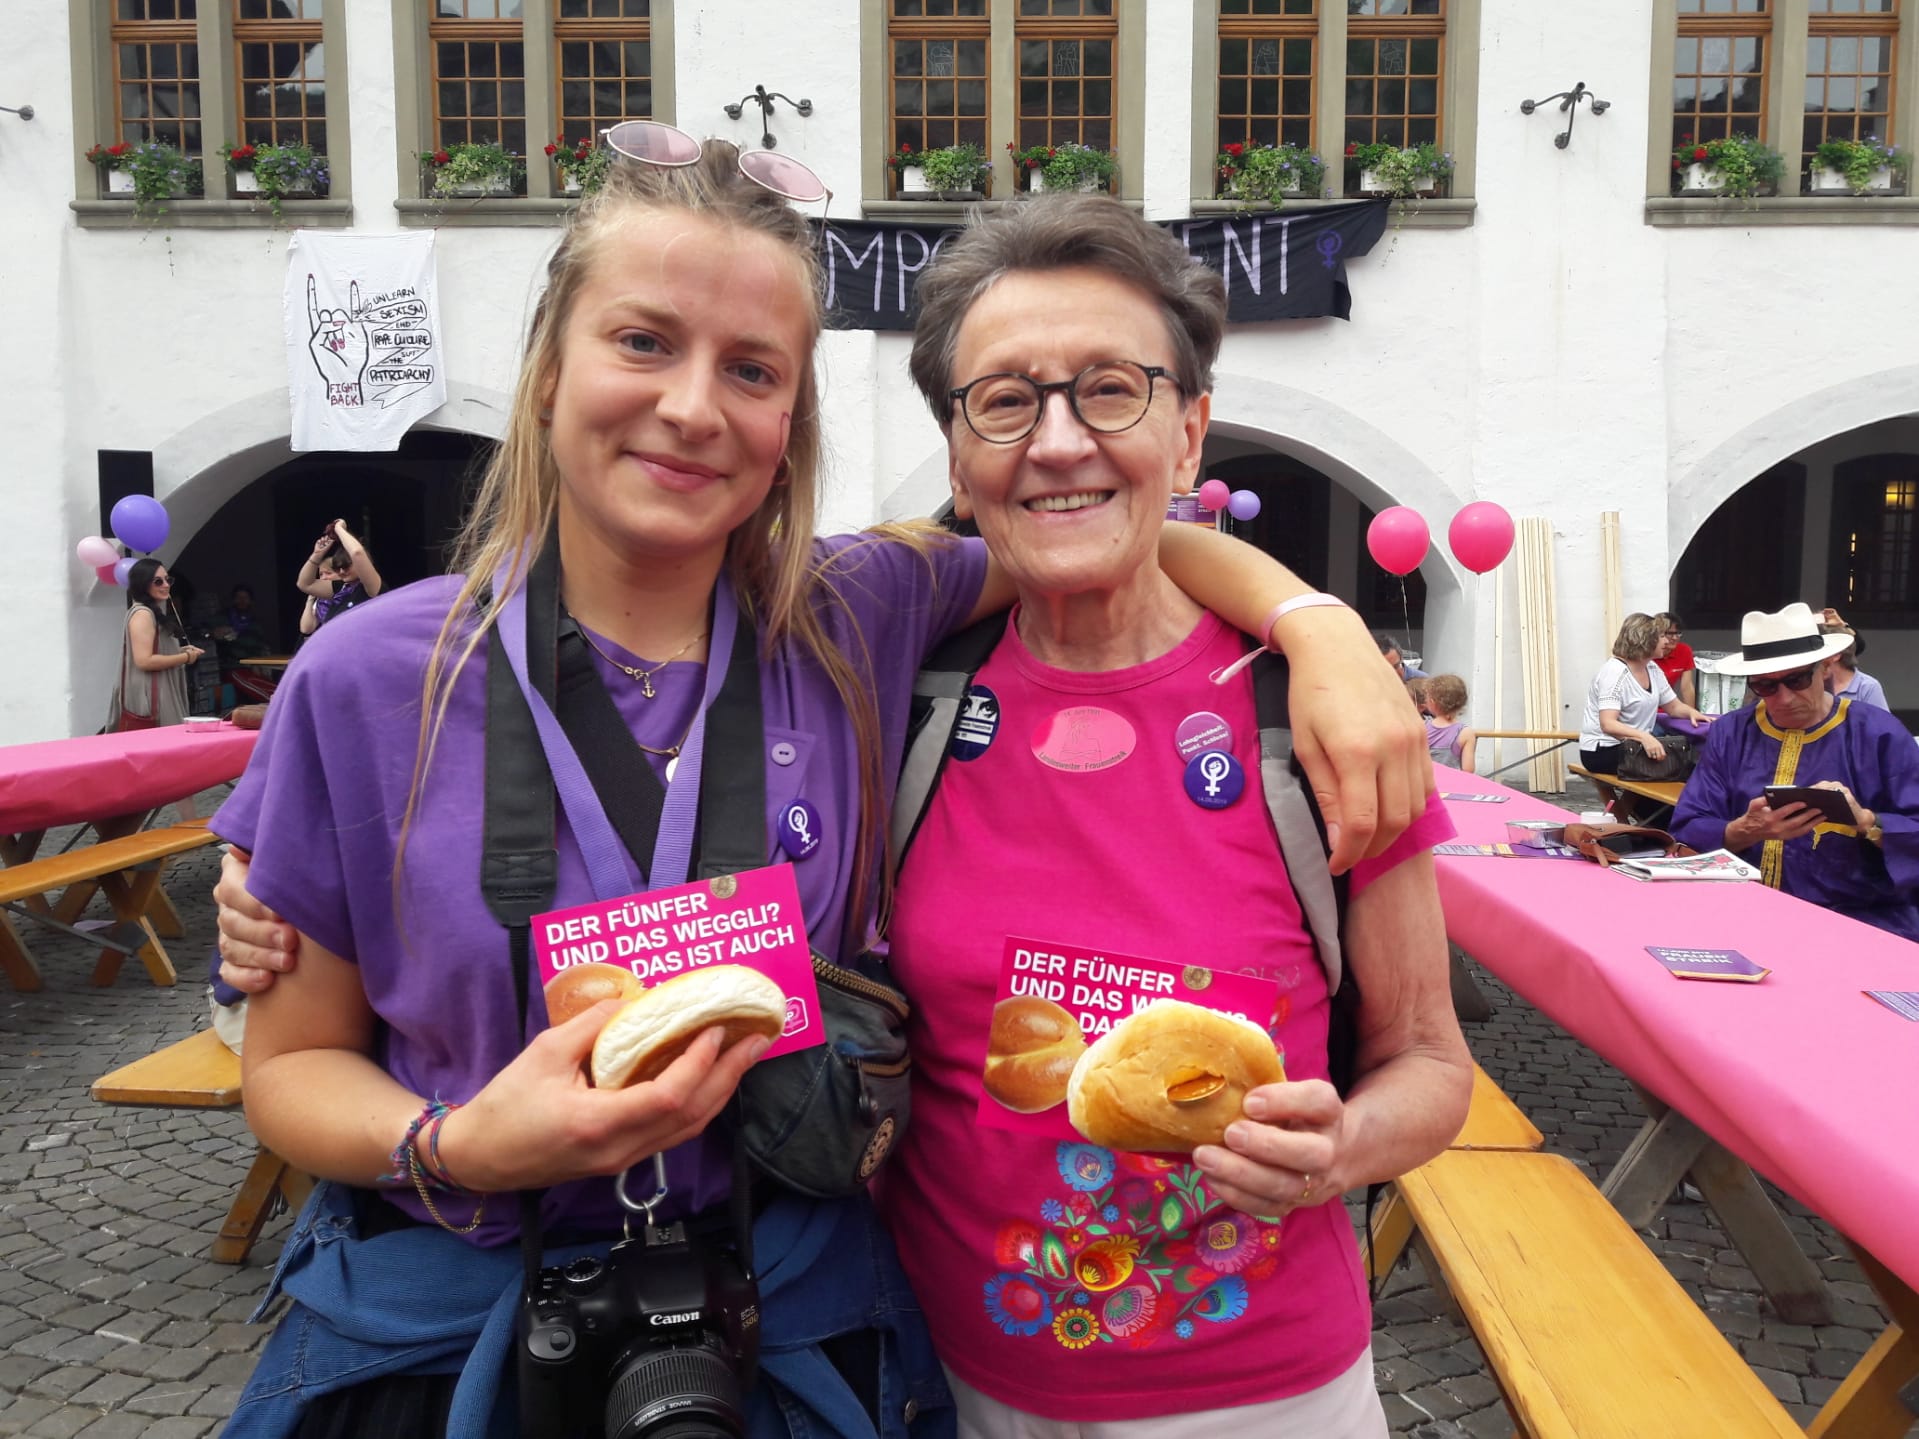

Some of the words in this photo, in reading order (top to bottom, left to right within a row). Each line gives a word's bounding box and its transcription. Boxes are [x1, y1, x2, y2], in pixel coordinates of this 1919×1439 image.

[373, 286, 416, 304] UNLEARN
[379, 304, 424, 319] SEXISM
[374, 333, 392, 347] RAPE
[369, 368, 431, 383] PATRIARCHY
[329, 382, 360, 394] FIGHT
[330, 394, 359, 406] BACK
[545, 915, 603, 946] DER
[606, 892, 709, 932] FÜNFER
[550, 940, 610, 971] UND
[615, 927, 669, 957] DAS
[672, 902, 780, 943] WEGGLI?
[630, 950, 684, 980] DAS
[686, 940, 725, 968] IST
[730, 924, 795, 958] AUCH
[1659, 951, 1729, 960] FRAUEN
[1665, 956, 1734, 964] STREIK
[1013, 948, 1067, 977] DER
[1072, 955, 1176, 995] FÜNFER
[1010, 974, 1066, 1002] UND
[1071, 984, 1124, 1012] DAS
[650, 1310, 700, 1326] Canon
[740, 1305, 755, 1321] EOS
